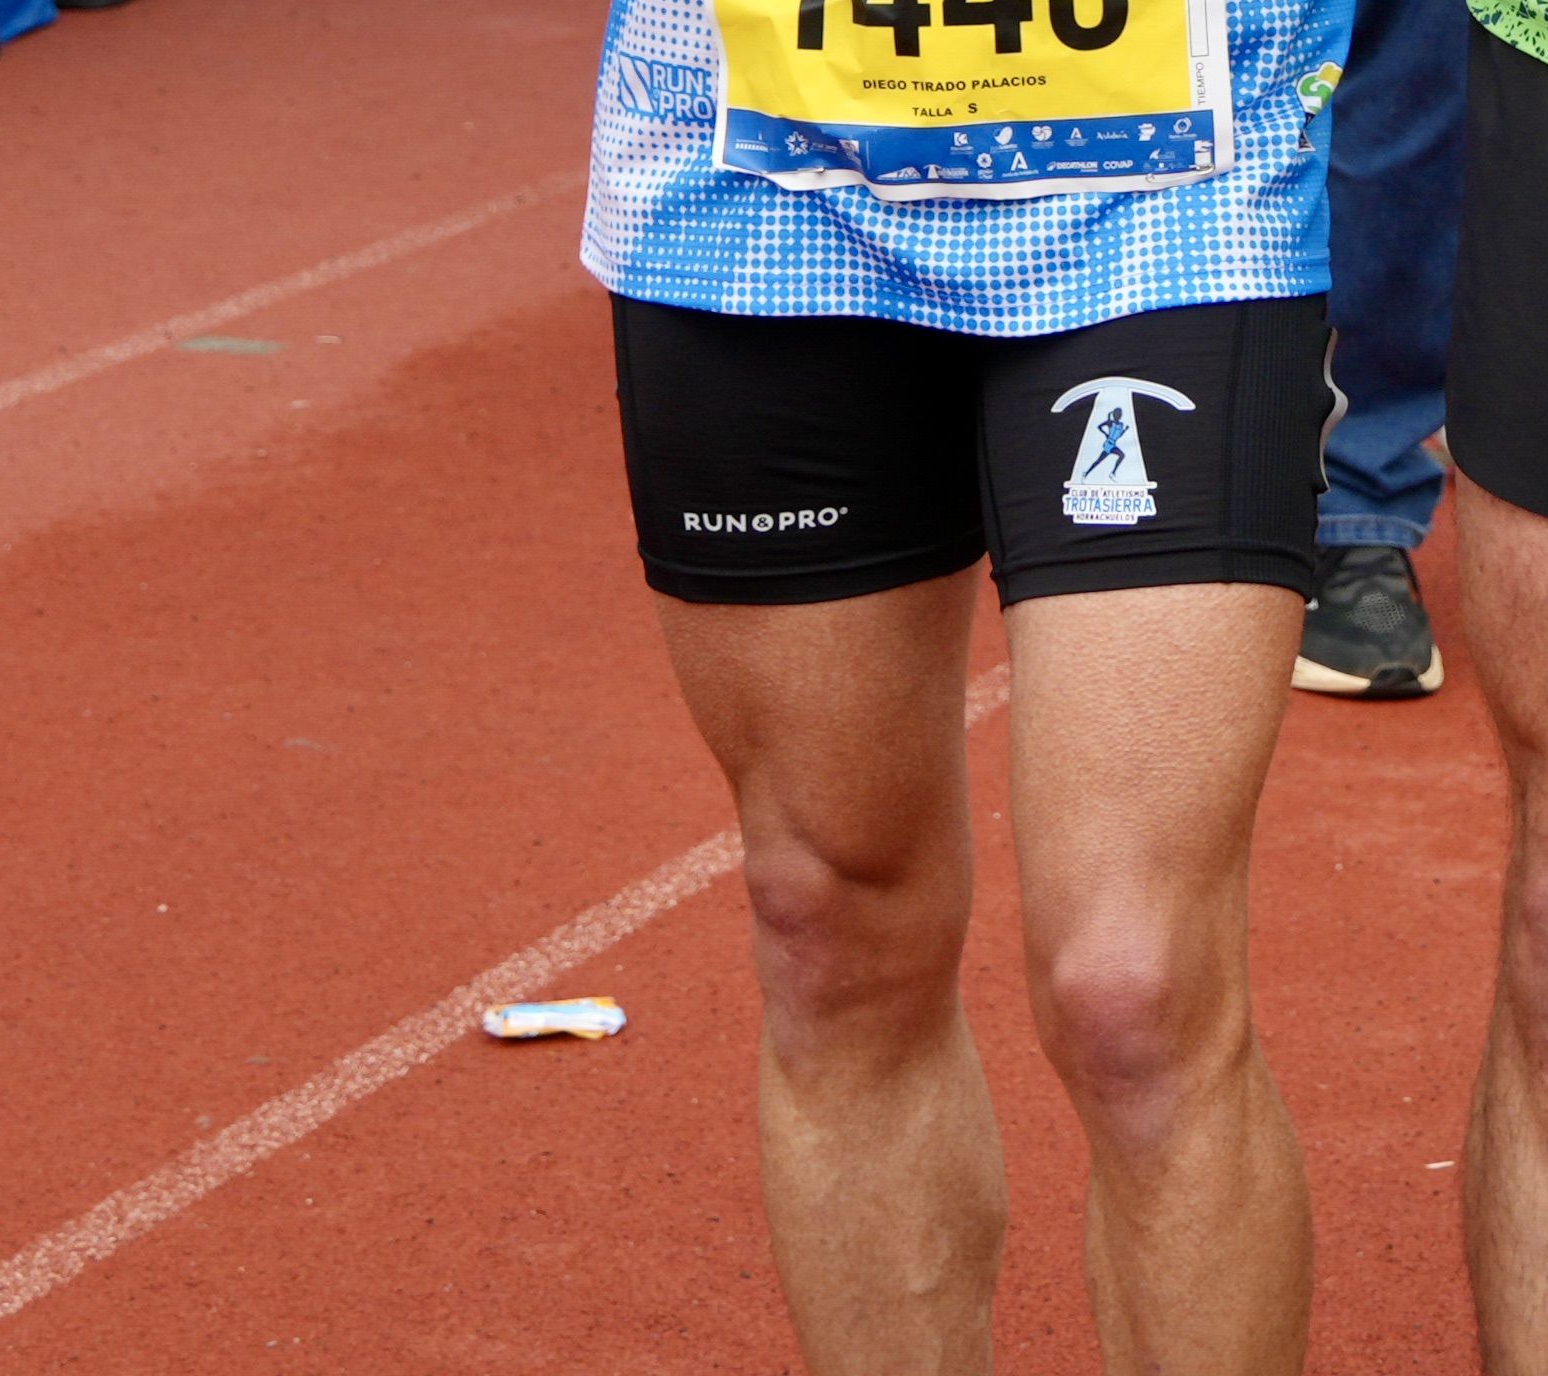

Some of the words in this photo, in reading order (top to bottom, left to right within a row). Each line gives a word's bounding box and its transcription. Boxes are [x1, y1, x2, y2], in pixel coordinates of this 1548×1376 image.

[651, 62, 704, 96] RUN
[862, 79, 908, 91] DIEGO
[911, 79, 967, 92] TIRADO
[971, 75, 1047, 90] PALACIOS
[1197, 61, 1207, 106] TIEMPO
[657, 89, 714, 120] PRO
[912, 106, 953, 118] TALLA
[967, 102, 979, 115] S
[1102, 159, 1134, 170] COVAP
[1101, 488, 1145, 498] ATLETISMO
[1063, 496, 1154, 515] TROTASIERRA
